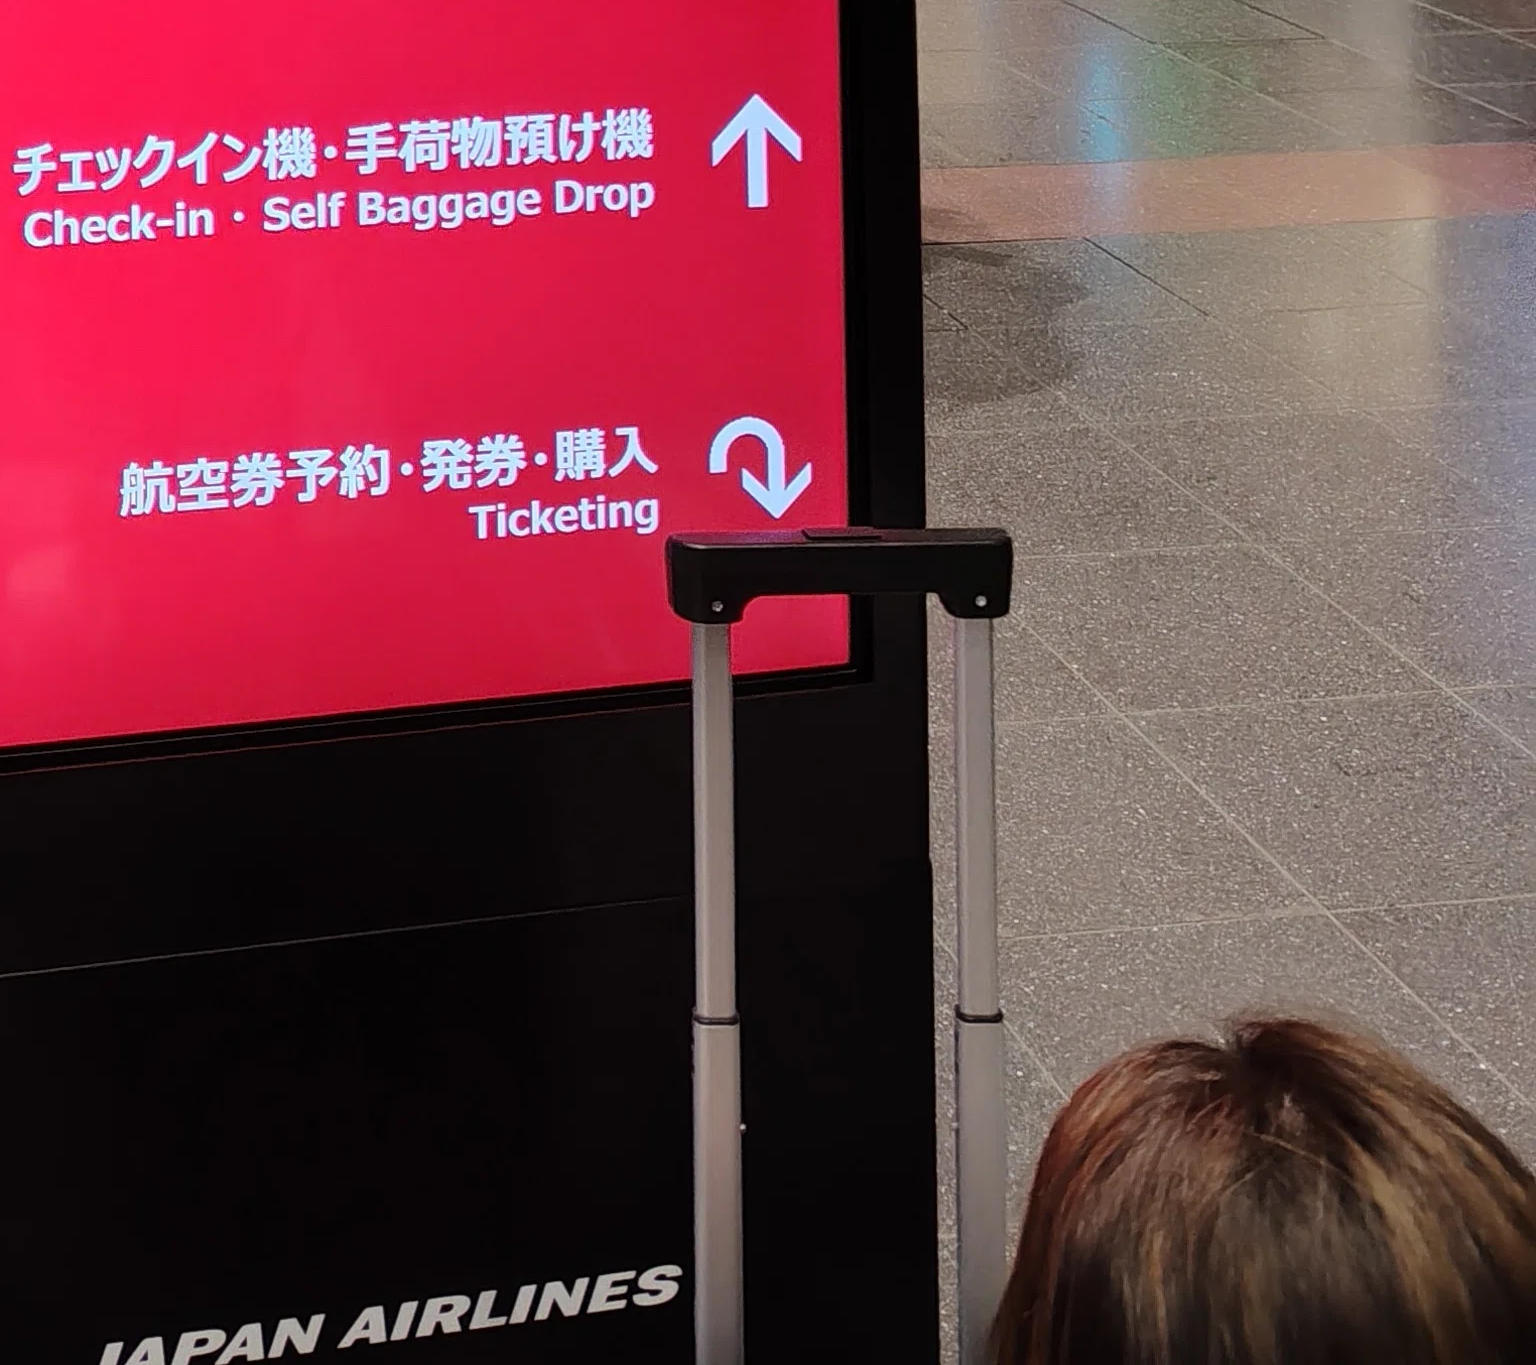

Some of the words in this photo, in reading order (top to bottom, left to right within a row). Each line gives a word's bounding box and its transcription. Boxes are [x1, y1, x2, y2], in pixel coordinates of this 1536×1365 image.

[12, 108, 654, 197] チェックイン機・手荷物預け機
[23, 201, 214, 248] Check-in
[263, 191, 347, 232] Self
[358, 188, 542, 231] Baggage
[554, 179, 655, 219] Drop
[119, 427, 659, 518] 航空券予約・発券・購入
[467, 494, 659, 541] Ticketing
[99, 1313, 326, 1365] JAPAN
[337, 1264, 683, 1350] AIRLINES
